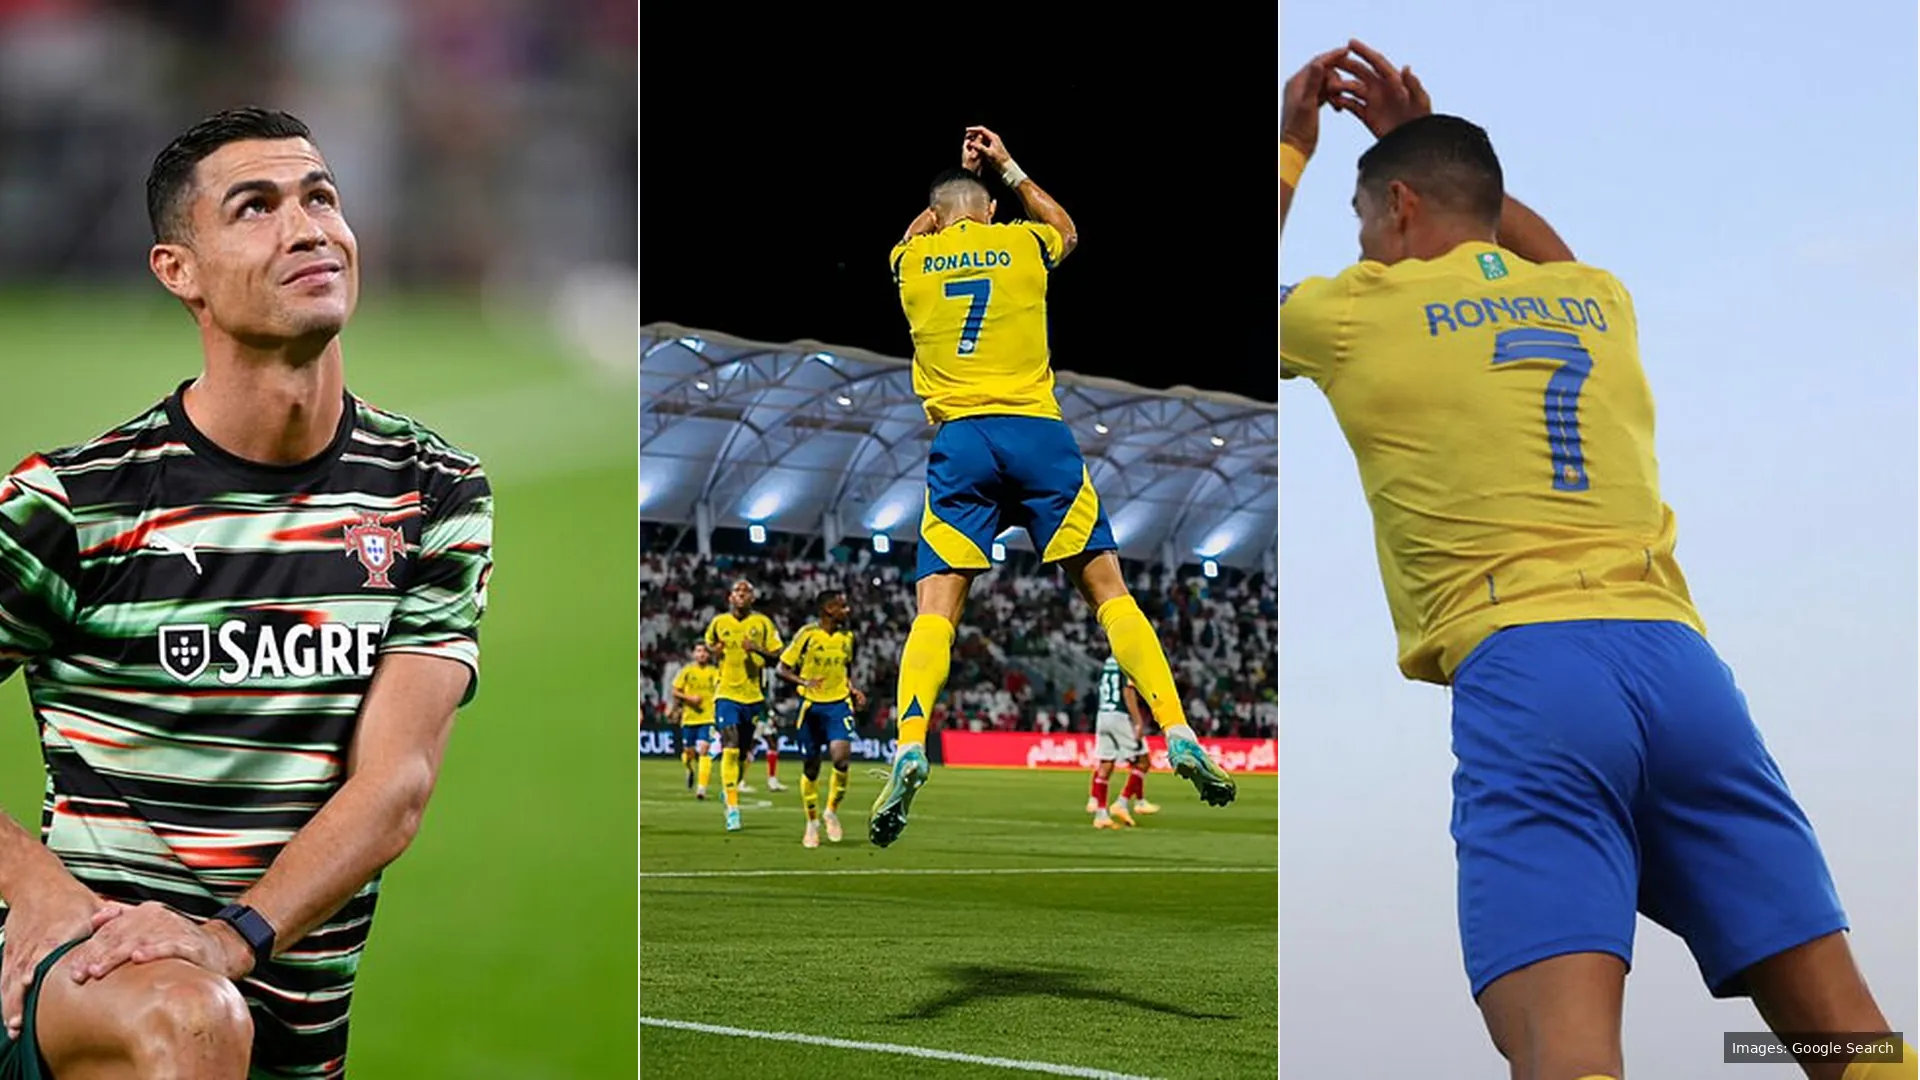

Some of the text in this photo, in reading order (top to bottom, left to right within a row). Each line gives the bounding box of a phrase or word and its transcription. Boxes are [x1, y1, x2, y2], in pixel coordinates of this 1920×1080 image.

[923, 250, 1011, 274] RONALDO
[944, 278, 992, 355] 7
[1424, 297, 1607, 336] RONALDO
[1492, 328, 1594, 491] 7
[217, 619, 390, 684] SAGRE
